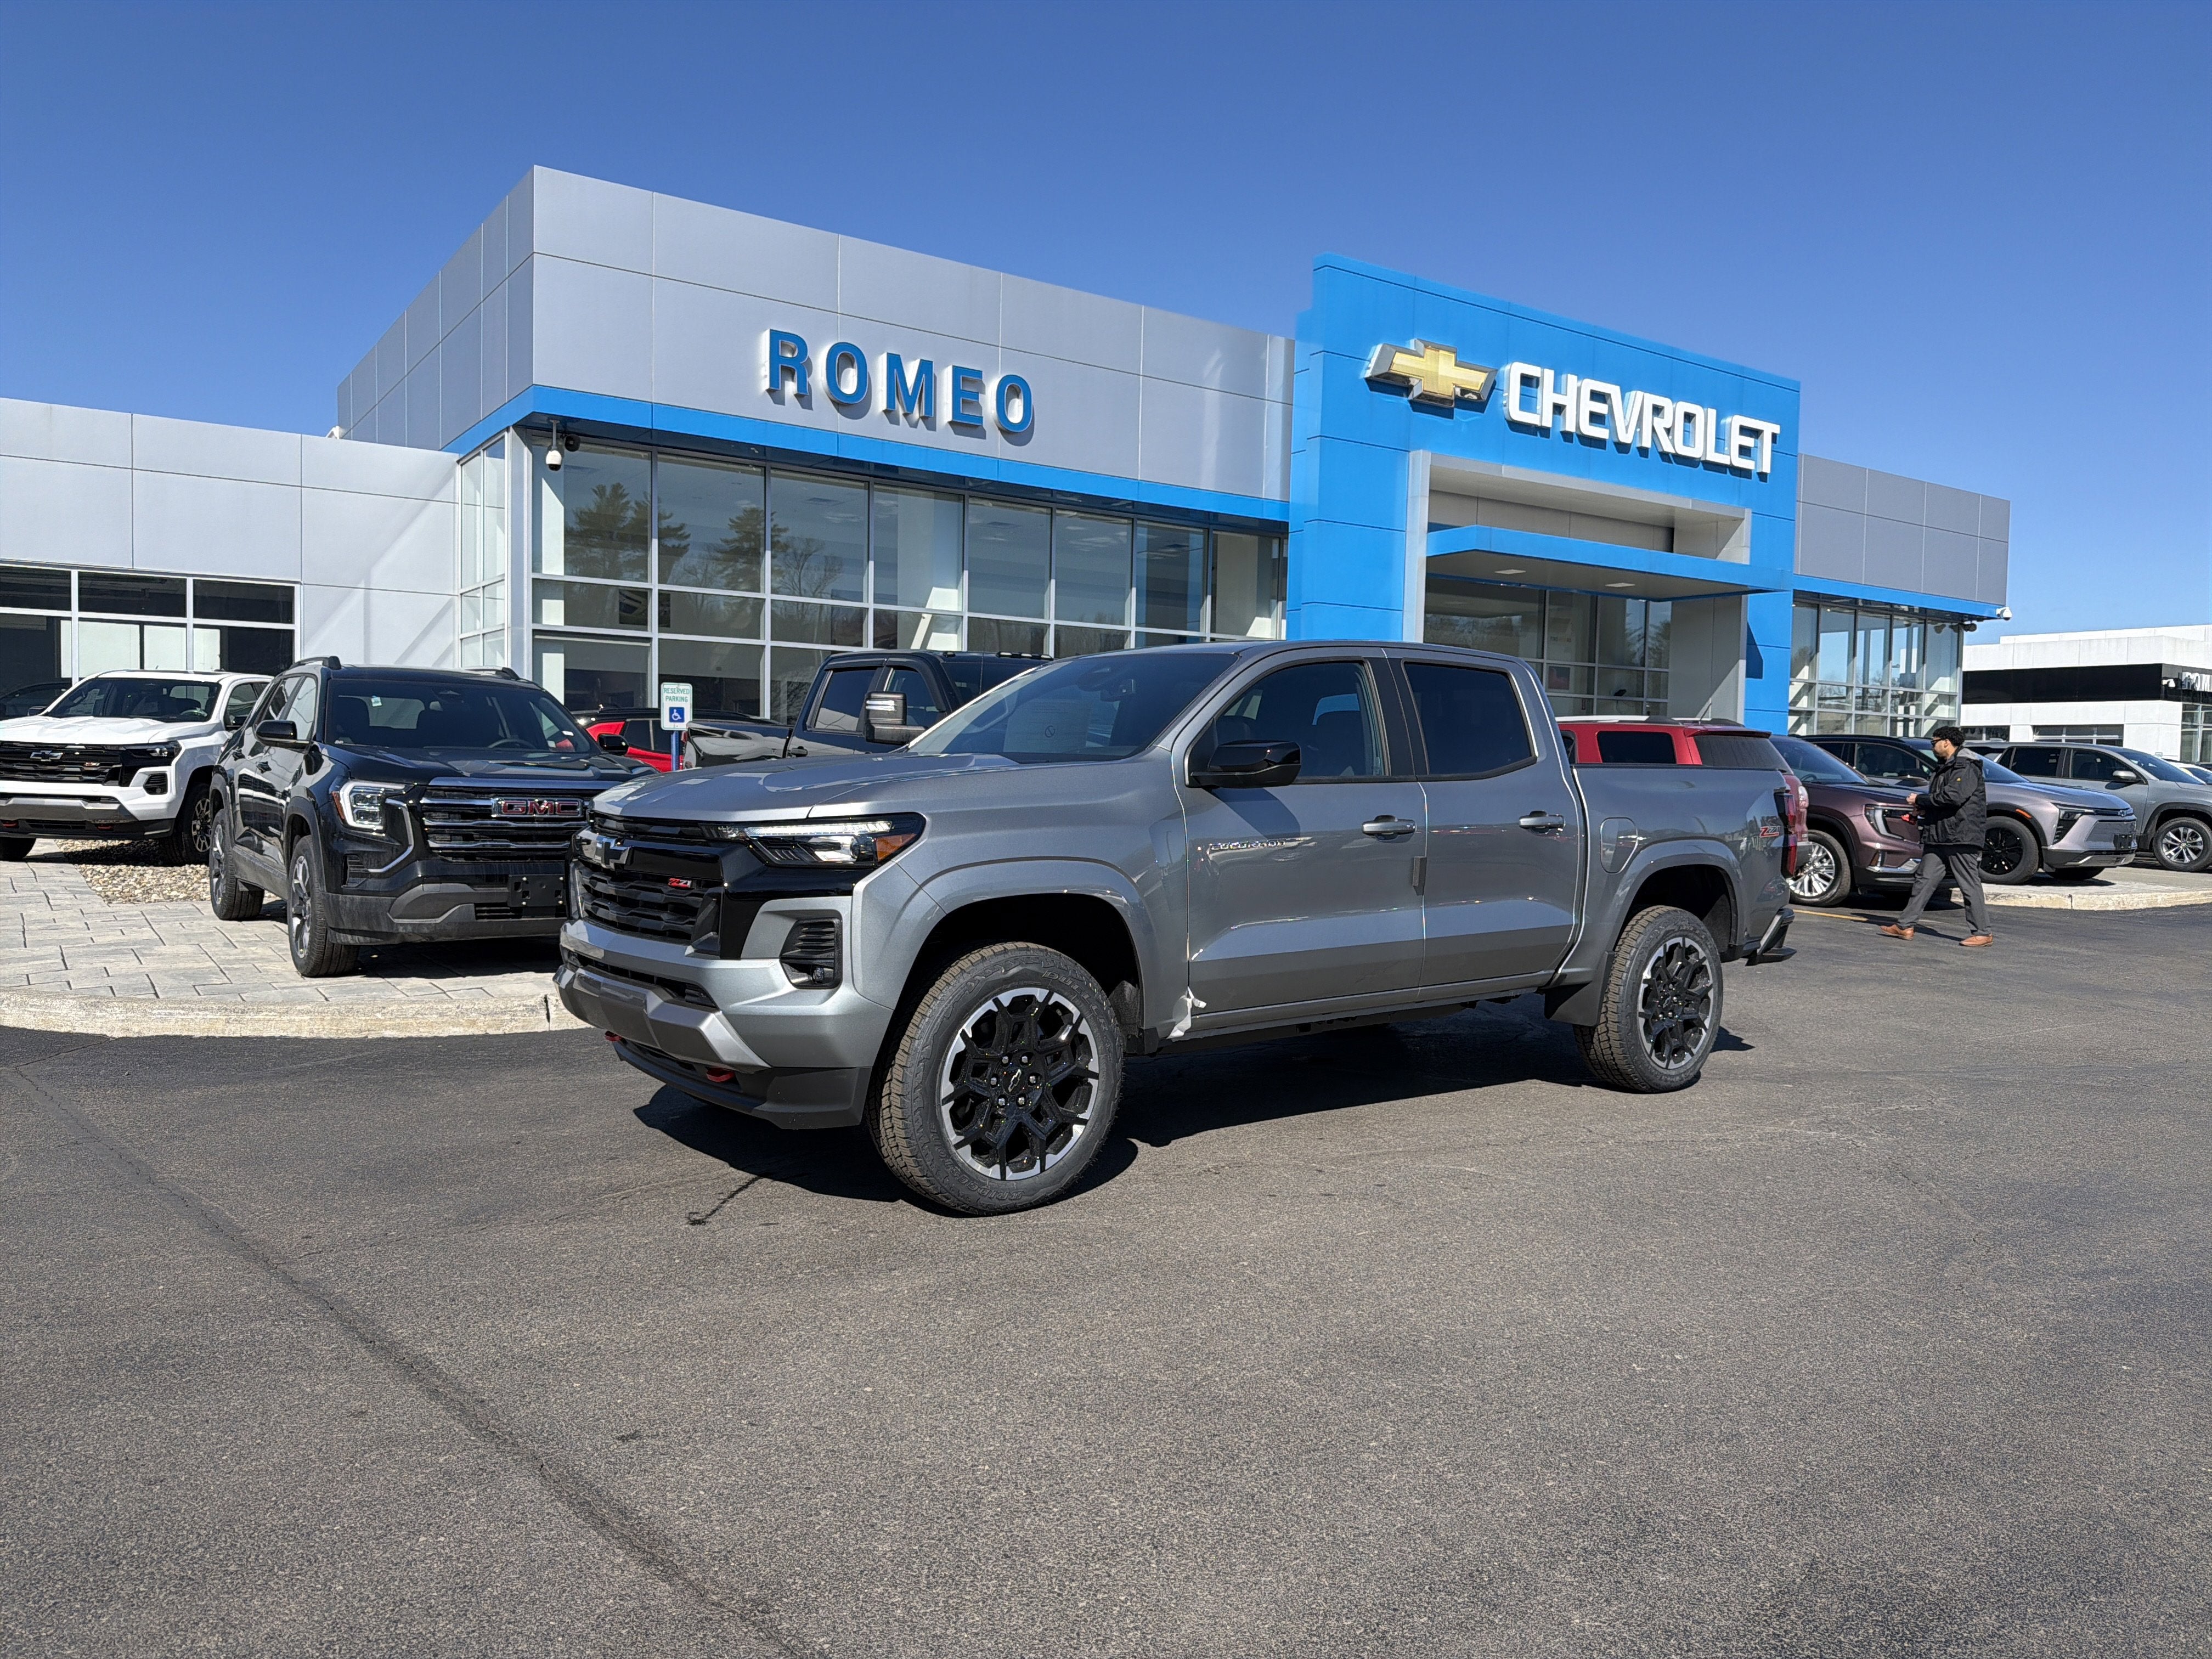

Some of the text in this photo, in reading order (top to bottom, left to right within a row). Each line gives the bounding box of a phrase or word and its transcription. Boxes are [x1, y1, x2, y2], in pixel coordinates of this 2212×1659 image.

[768, 329, 1034, 433] ROMEO
[1505, 361, 1781, 474] CHEVROLET
[2182, 672, 2212, 692] ROM
[501, 799, 580, 815] GMC
[1759, 825, 1781, 838] Z71
